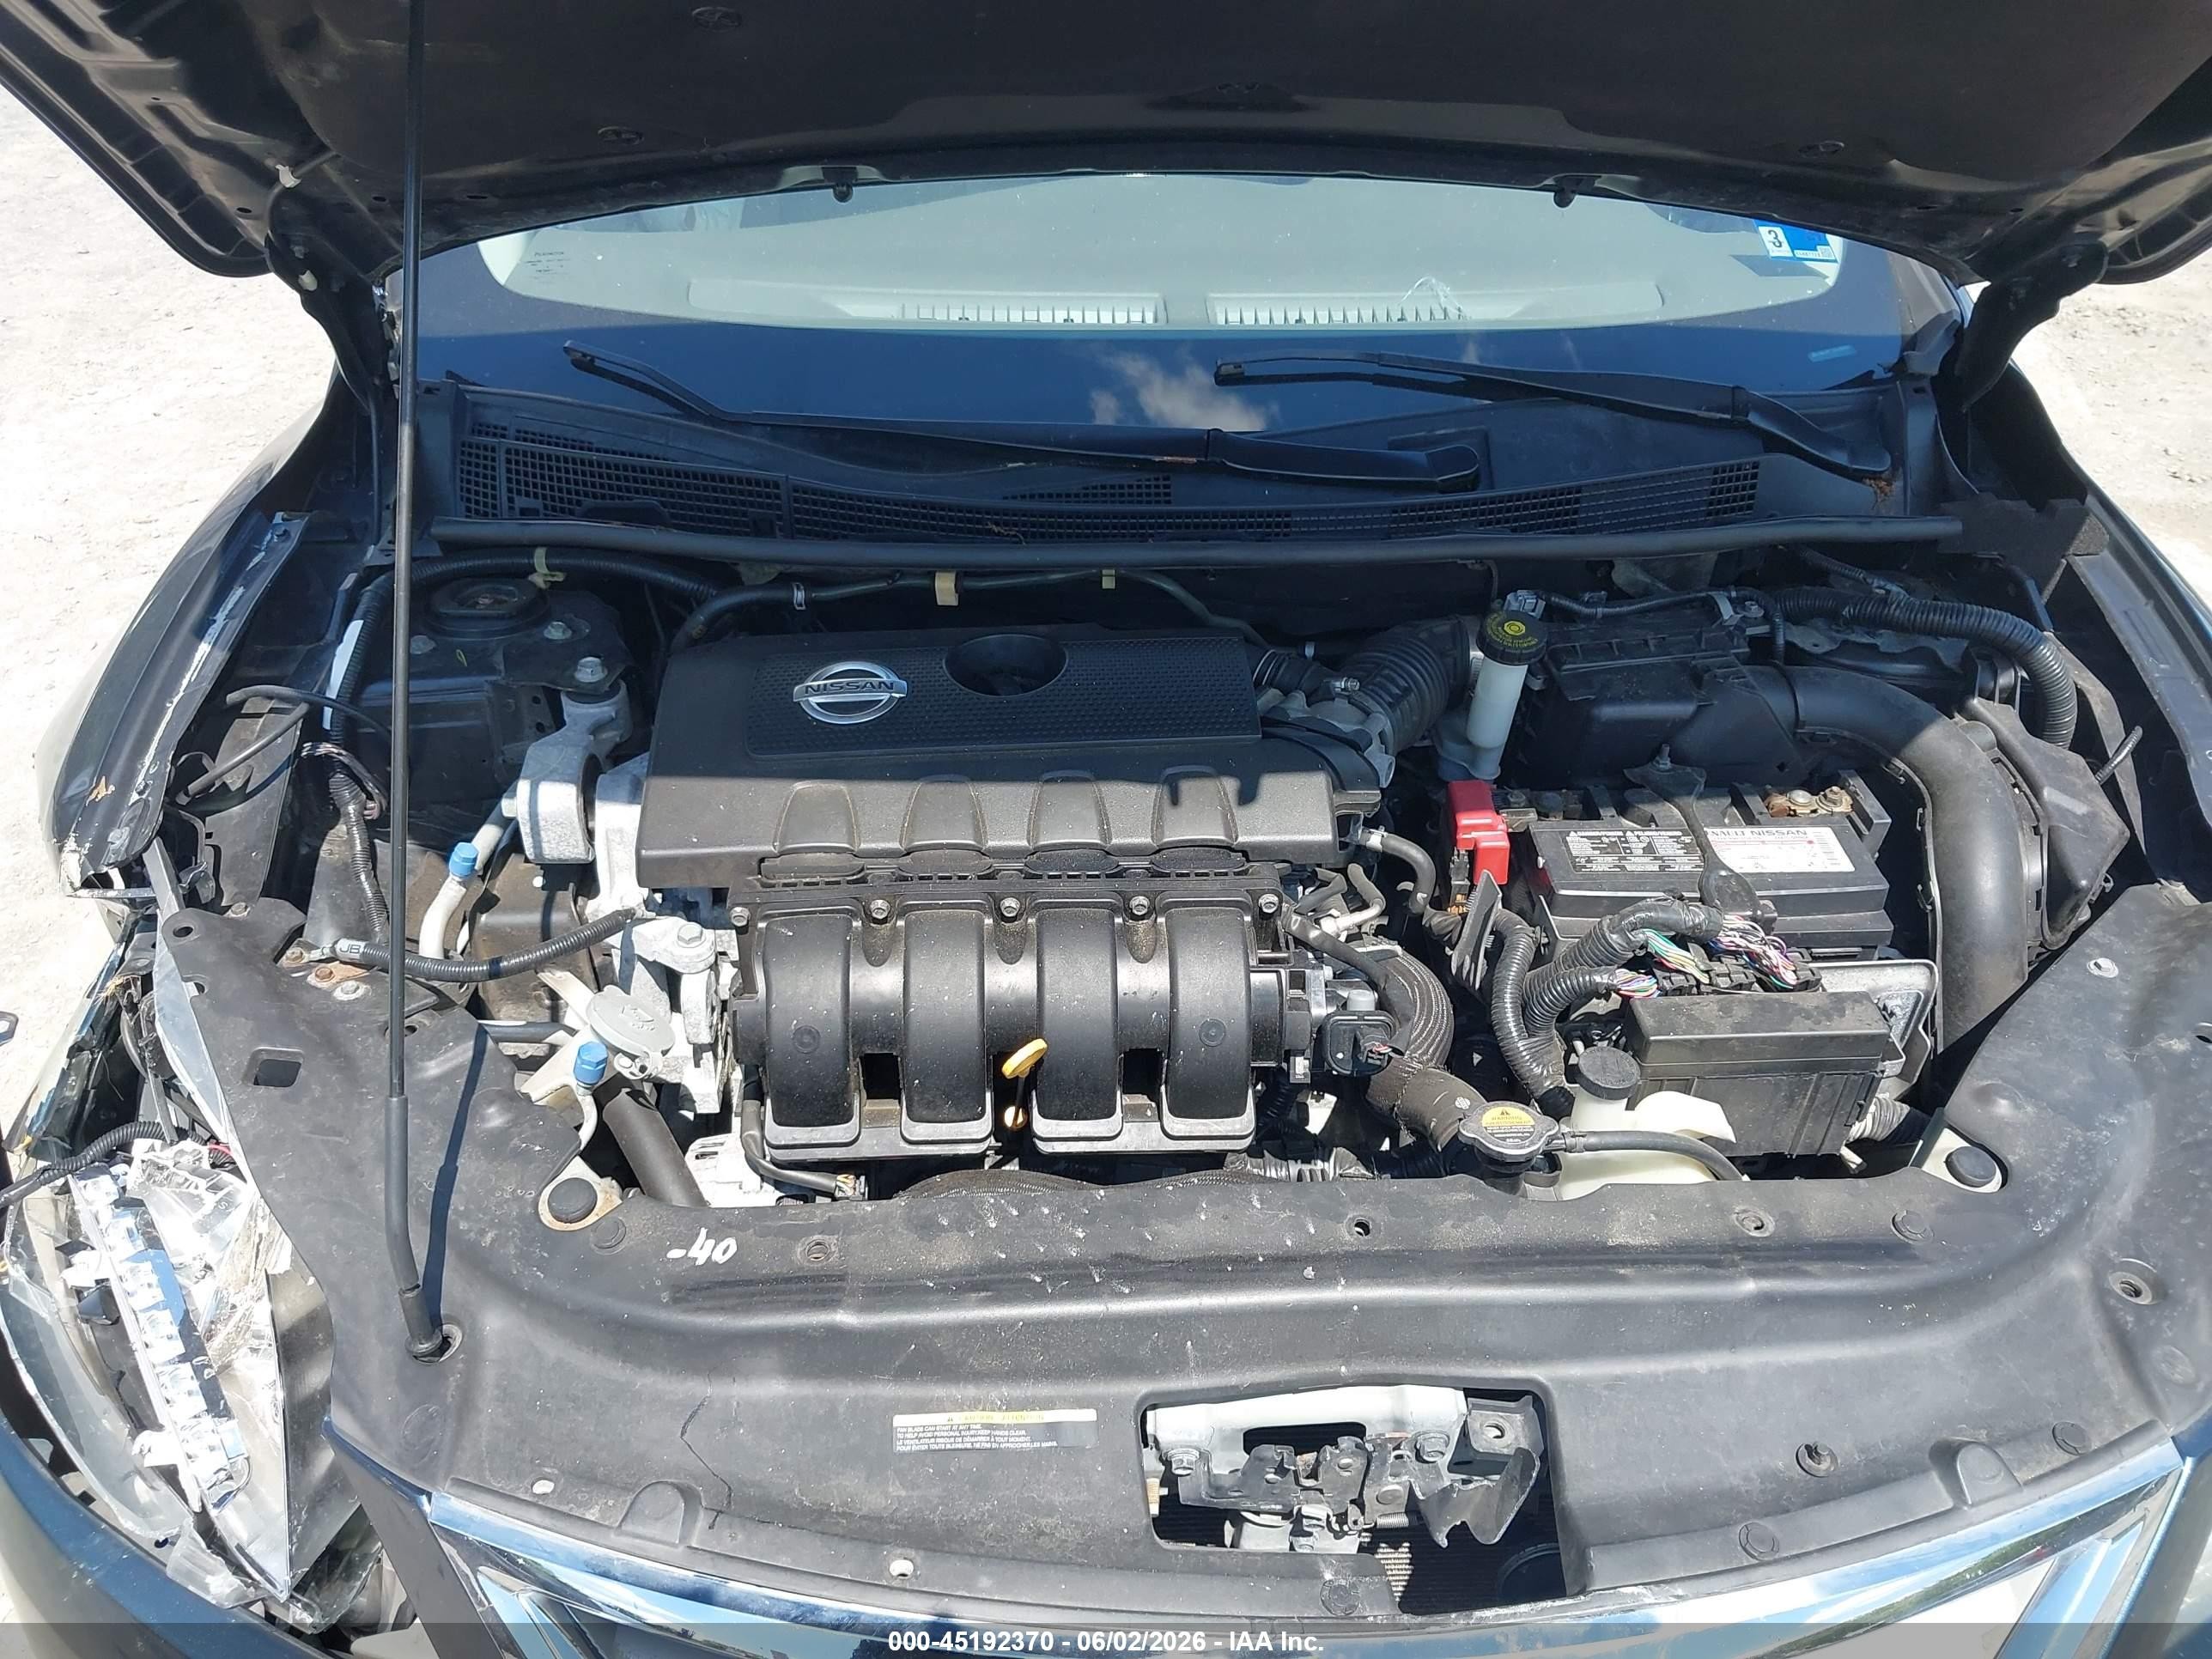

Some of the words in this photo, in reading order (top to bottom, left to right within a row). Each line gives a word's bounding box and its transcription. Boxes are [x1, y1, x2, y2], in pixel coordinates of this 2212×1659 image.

[1767, 229, 1783, 248] 3
[805, 681, 894, 695] NISSAN
[339, 944, 361, 954] JB
[666, 1227, 738, 1266] -40
